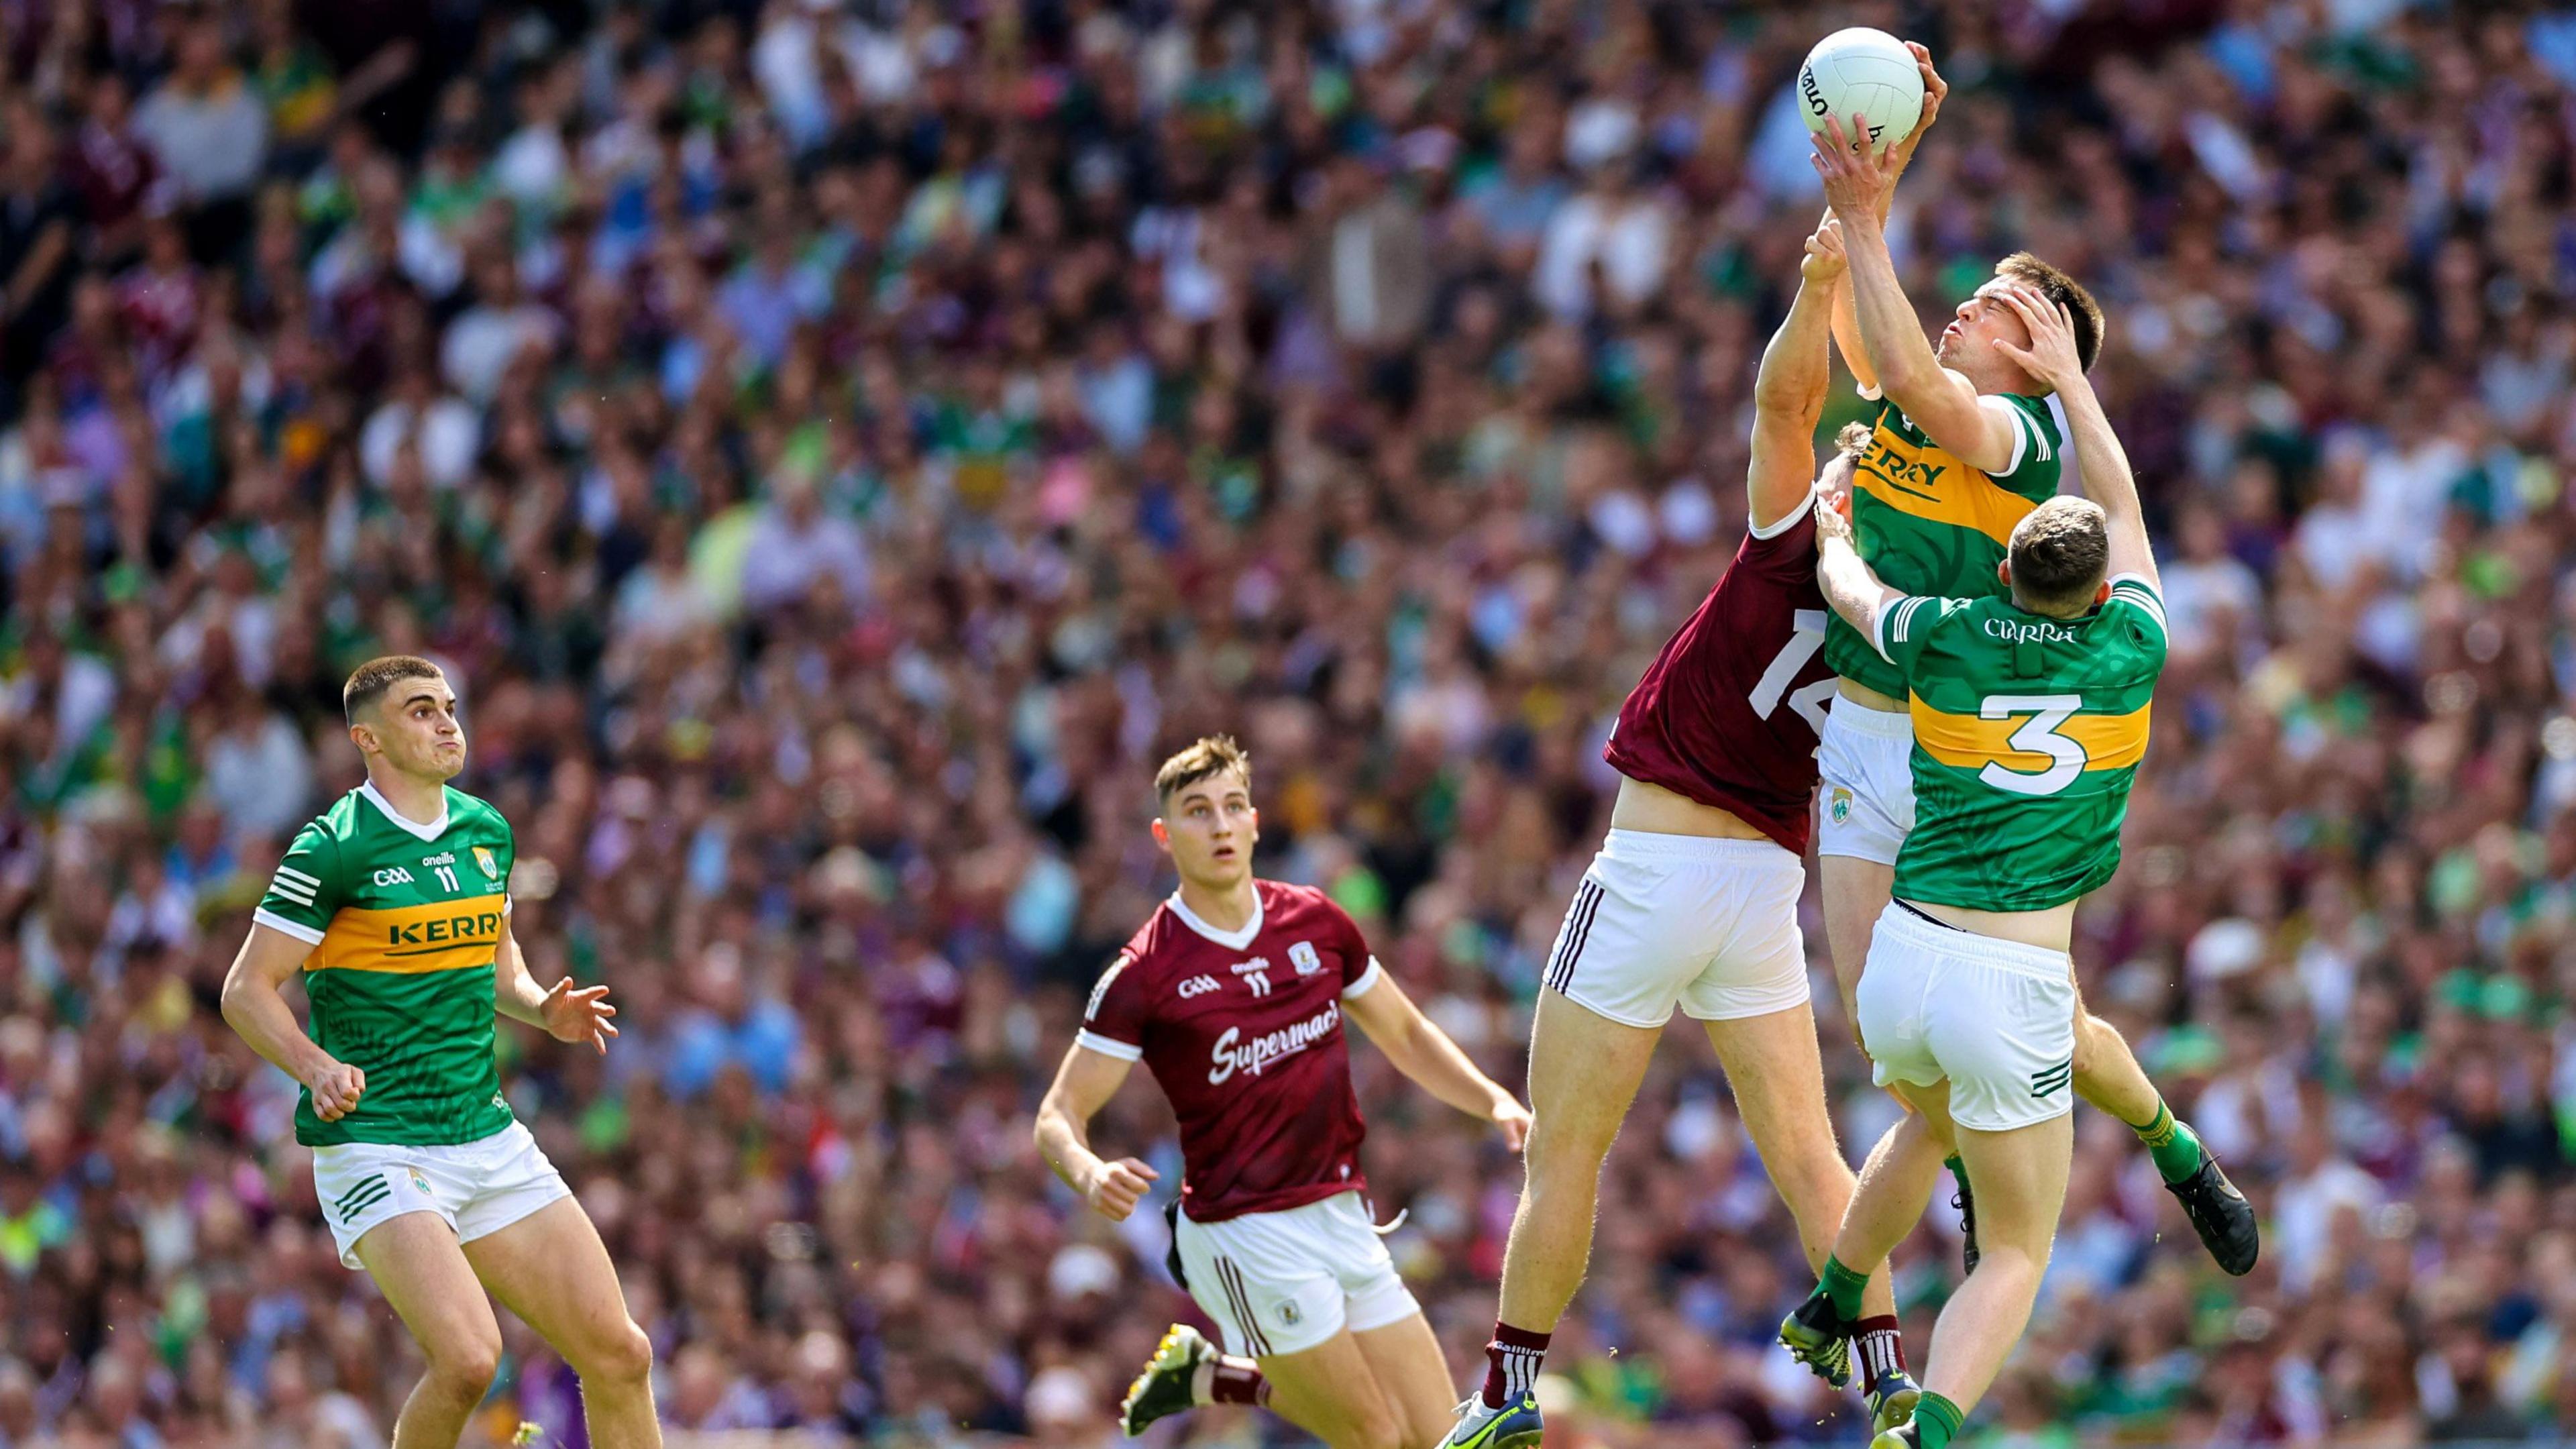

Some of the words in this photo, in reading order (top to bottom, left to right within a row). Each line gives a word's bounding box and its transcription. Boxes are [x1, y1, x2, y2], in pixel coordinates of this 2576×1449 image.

[1978, 694, 2088, 796] 3
[434, 865, 460, 893] 11
[1243, 970, 1271, 998] 11
